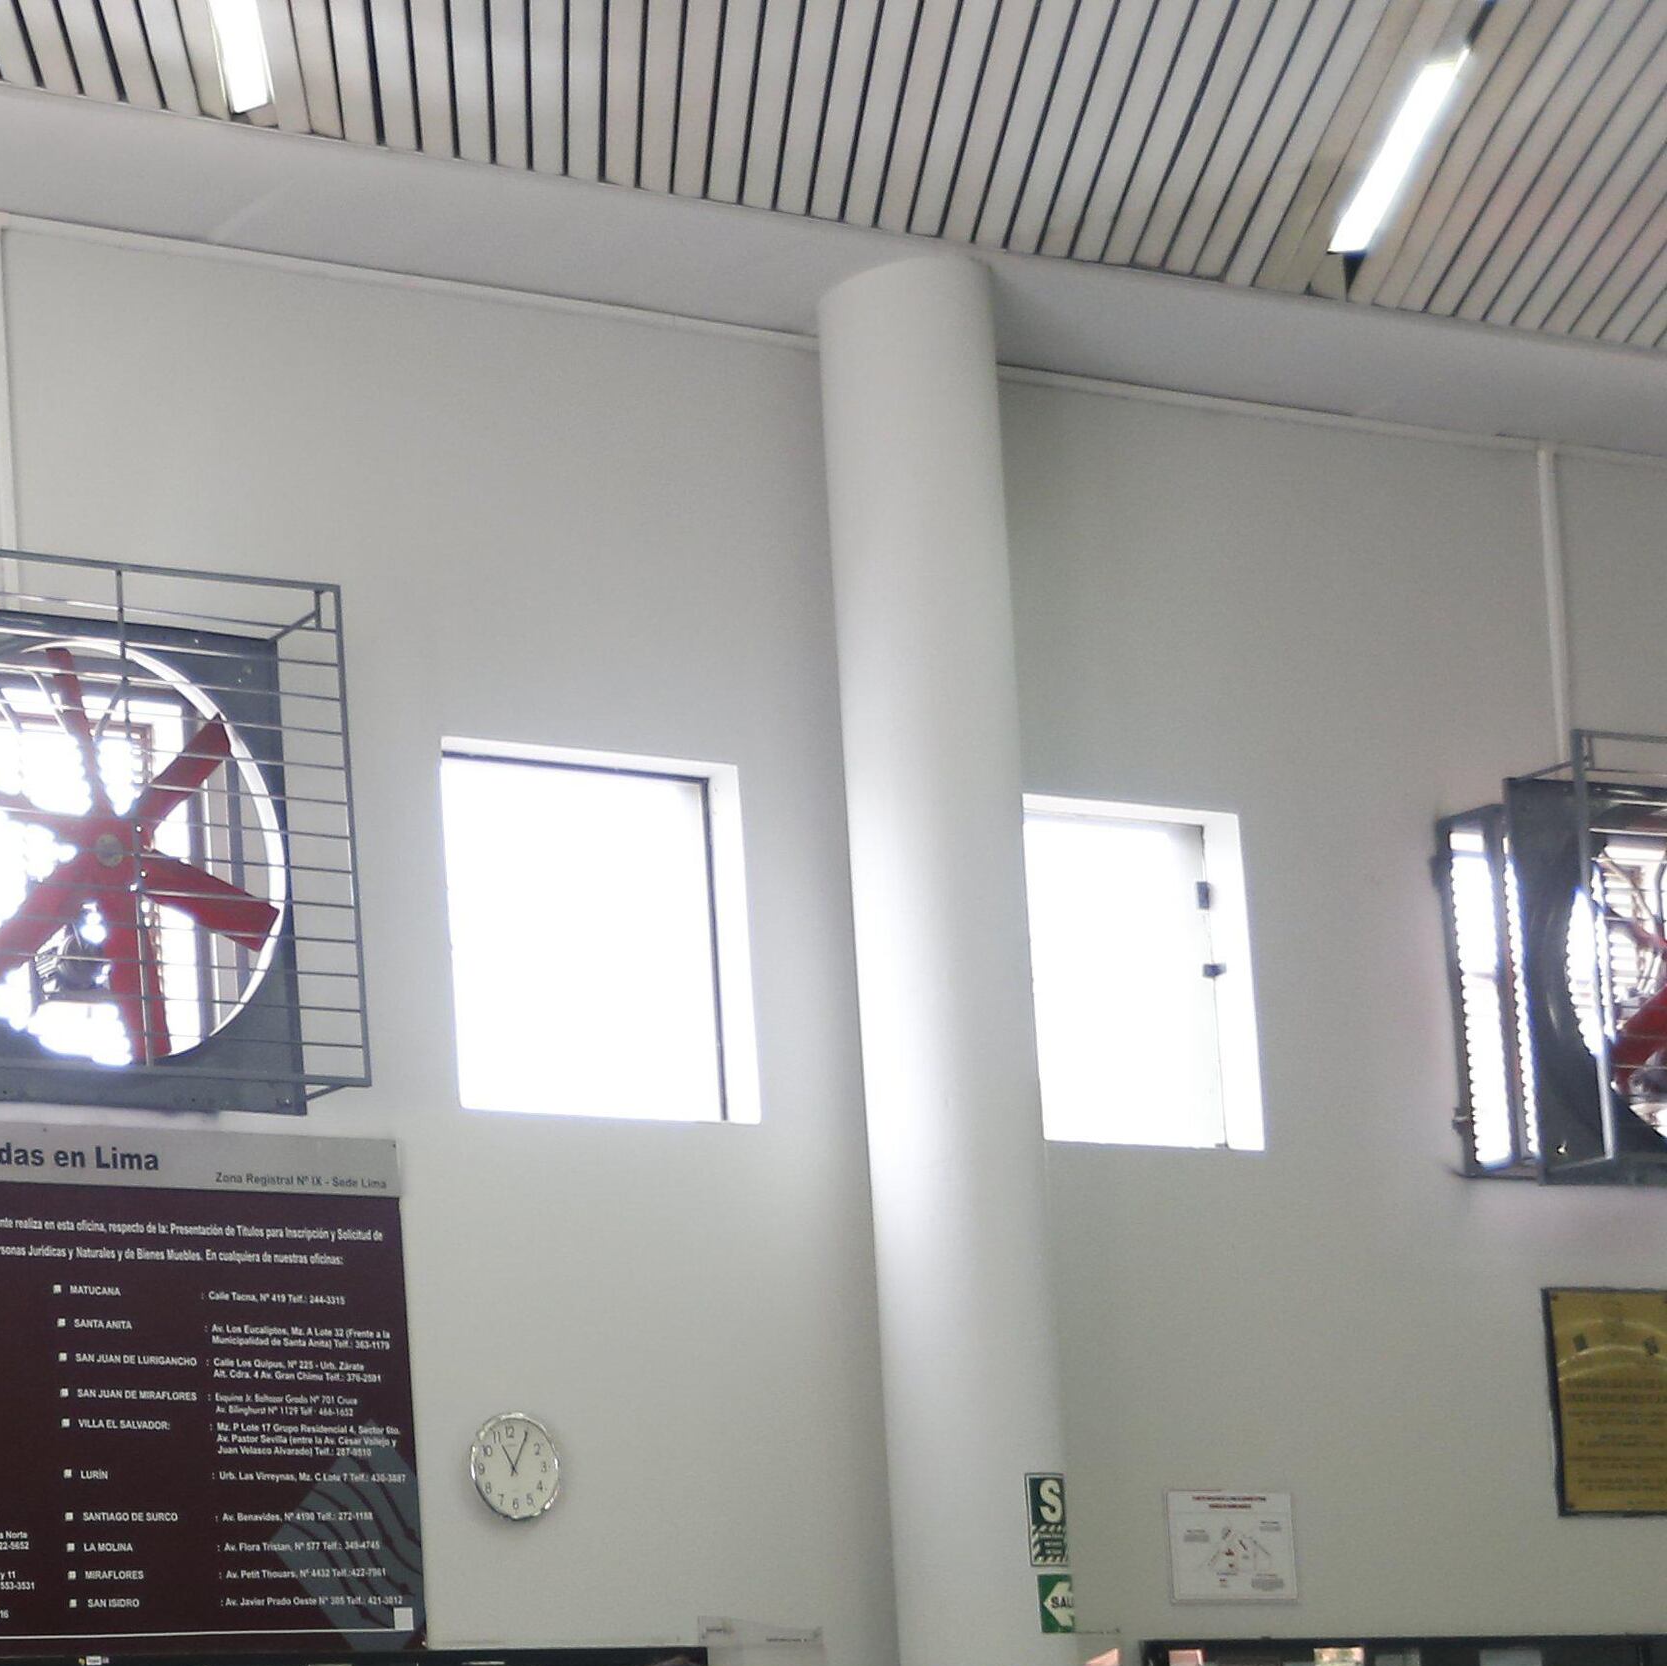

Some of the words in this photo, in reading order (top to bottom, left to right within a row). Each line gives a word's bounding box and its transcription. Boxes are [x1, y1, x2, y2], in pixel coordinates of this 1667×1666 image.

[53, 1150, 84, 1167] en
[95, 1146, 158, 1170] Lima
[70, 1285, 120, 1295] MATUCANA
[74, 1319, 104, 1327] SANTA
[105, 1320, 131, 1328] ANITA
[1039, 1479, 1064, 1523] S
[83, 1512, 129, 1521] SANTIAGO
[131, 1512, 142, 1521] DE
[146, 1512, 177, 1521] SURCO
[85, 1570, 143, 1579] MIRAFLORES
